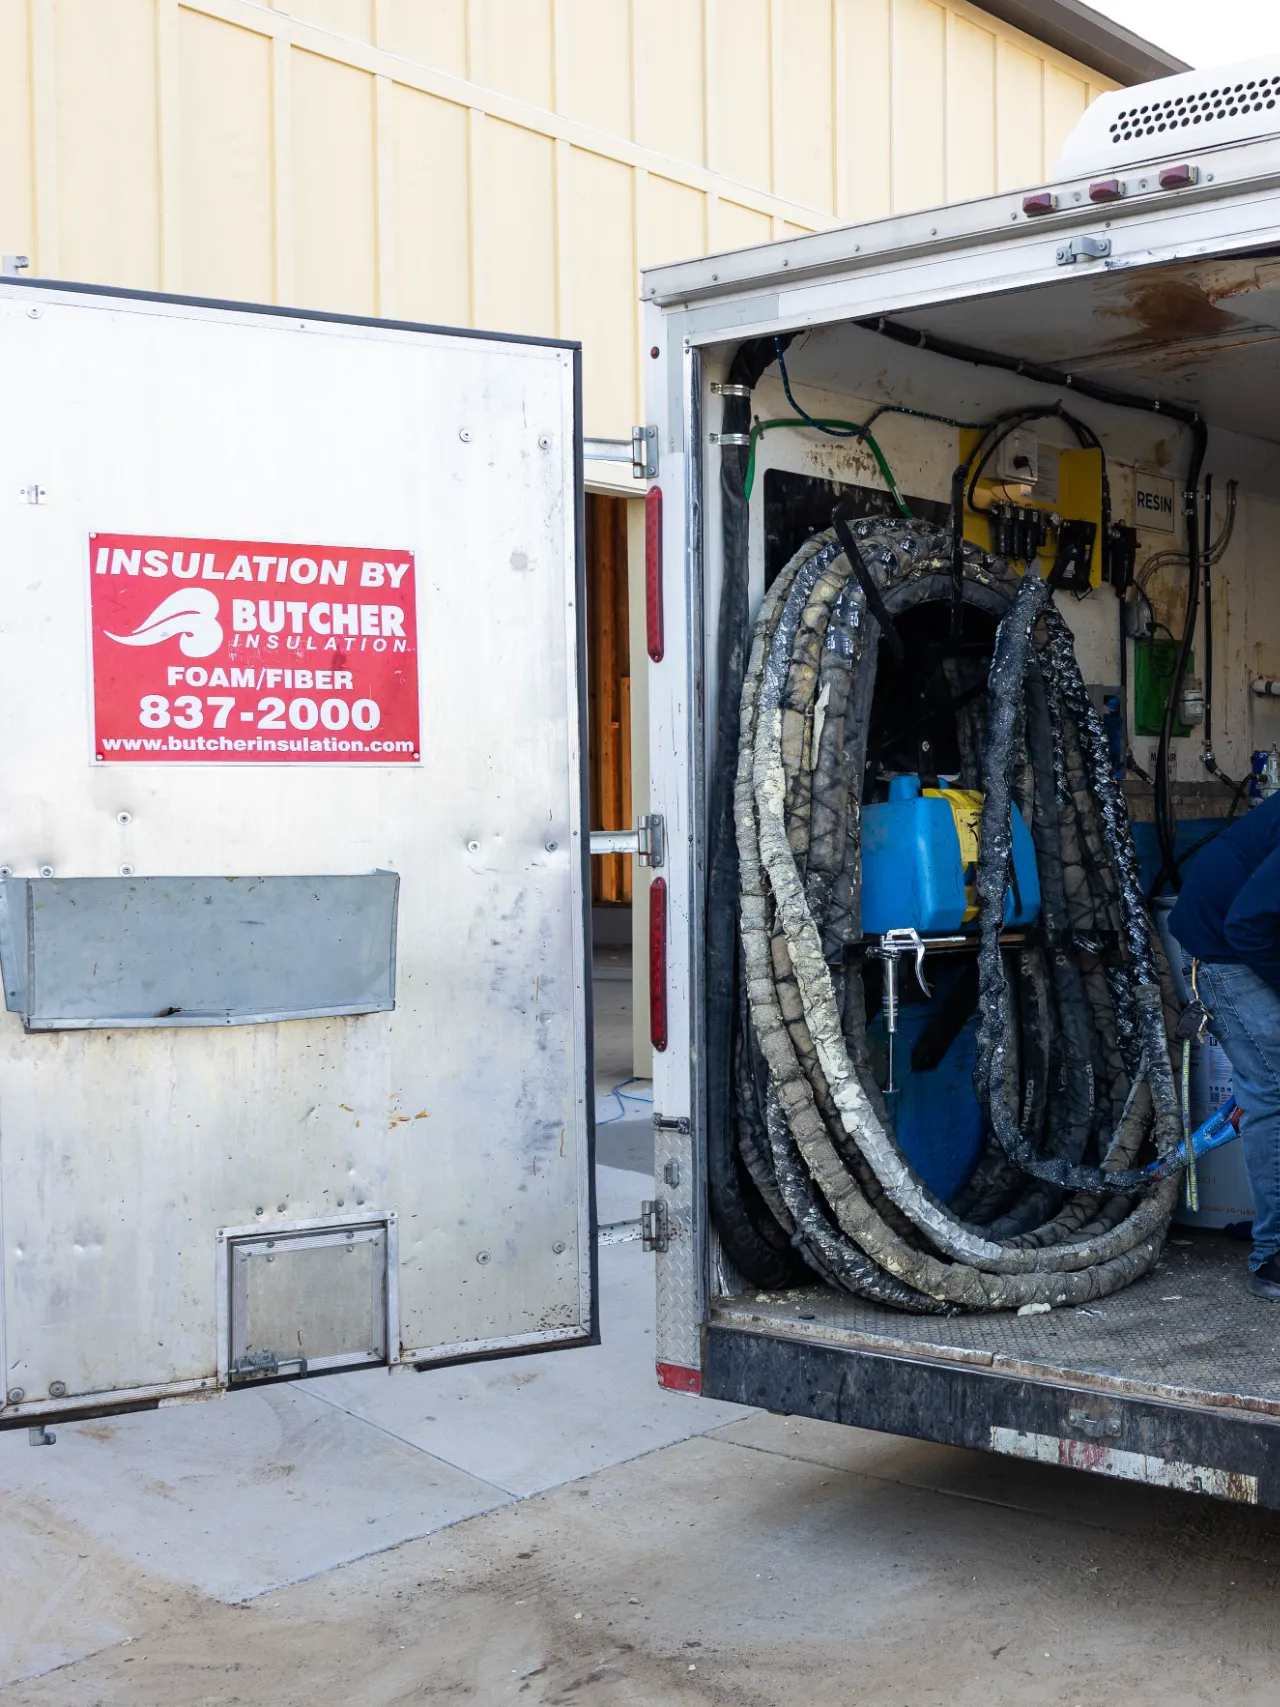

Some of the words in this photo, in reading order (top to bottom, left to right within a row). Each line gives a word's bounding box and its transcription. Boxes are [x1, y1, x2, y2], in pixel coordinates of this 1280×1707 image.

[1137, 490, 1172, 514] RESIN
[95, 548, 347, 586] INSULATION
[360, 561, 410, 588] BY
[232, 598, 406, 636] BUTCHER
[232, 634, 406, 653] INSULATION
[167, 666, 354, 690] FOAM/FIBER
[139, 694, 381, 730] 837-2000
[102, 735, 414, 752] www.butcherinsulation.com
